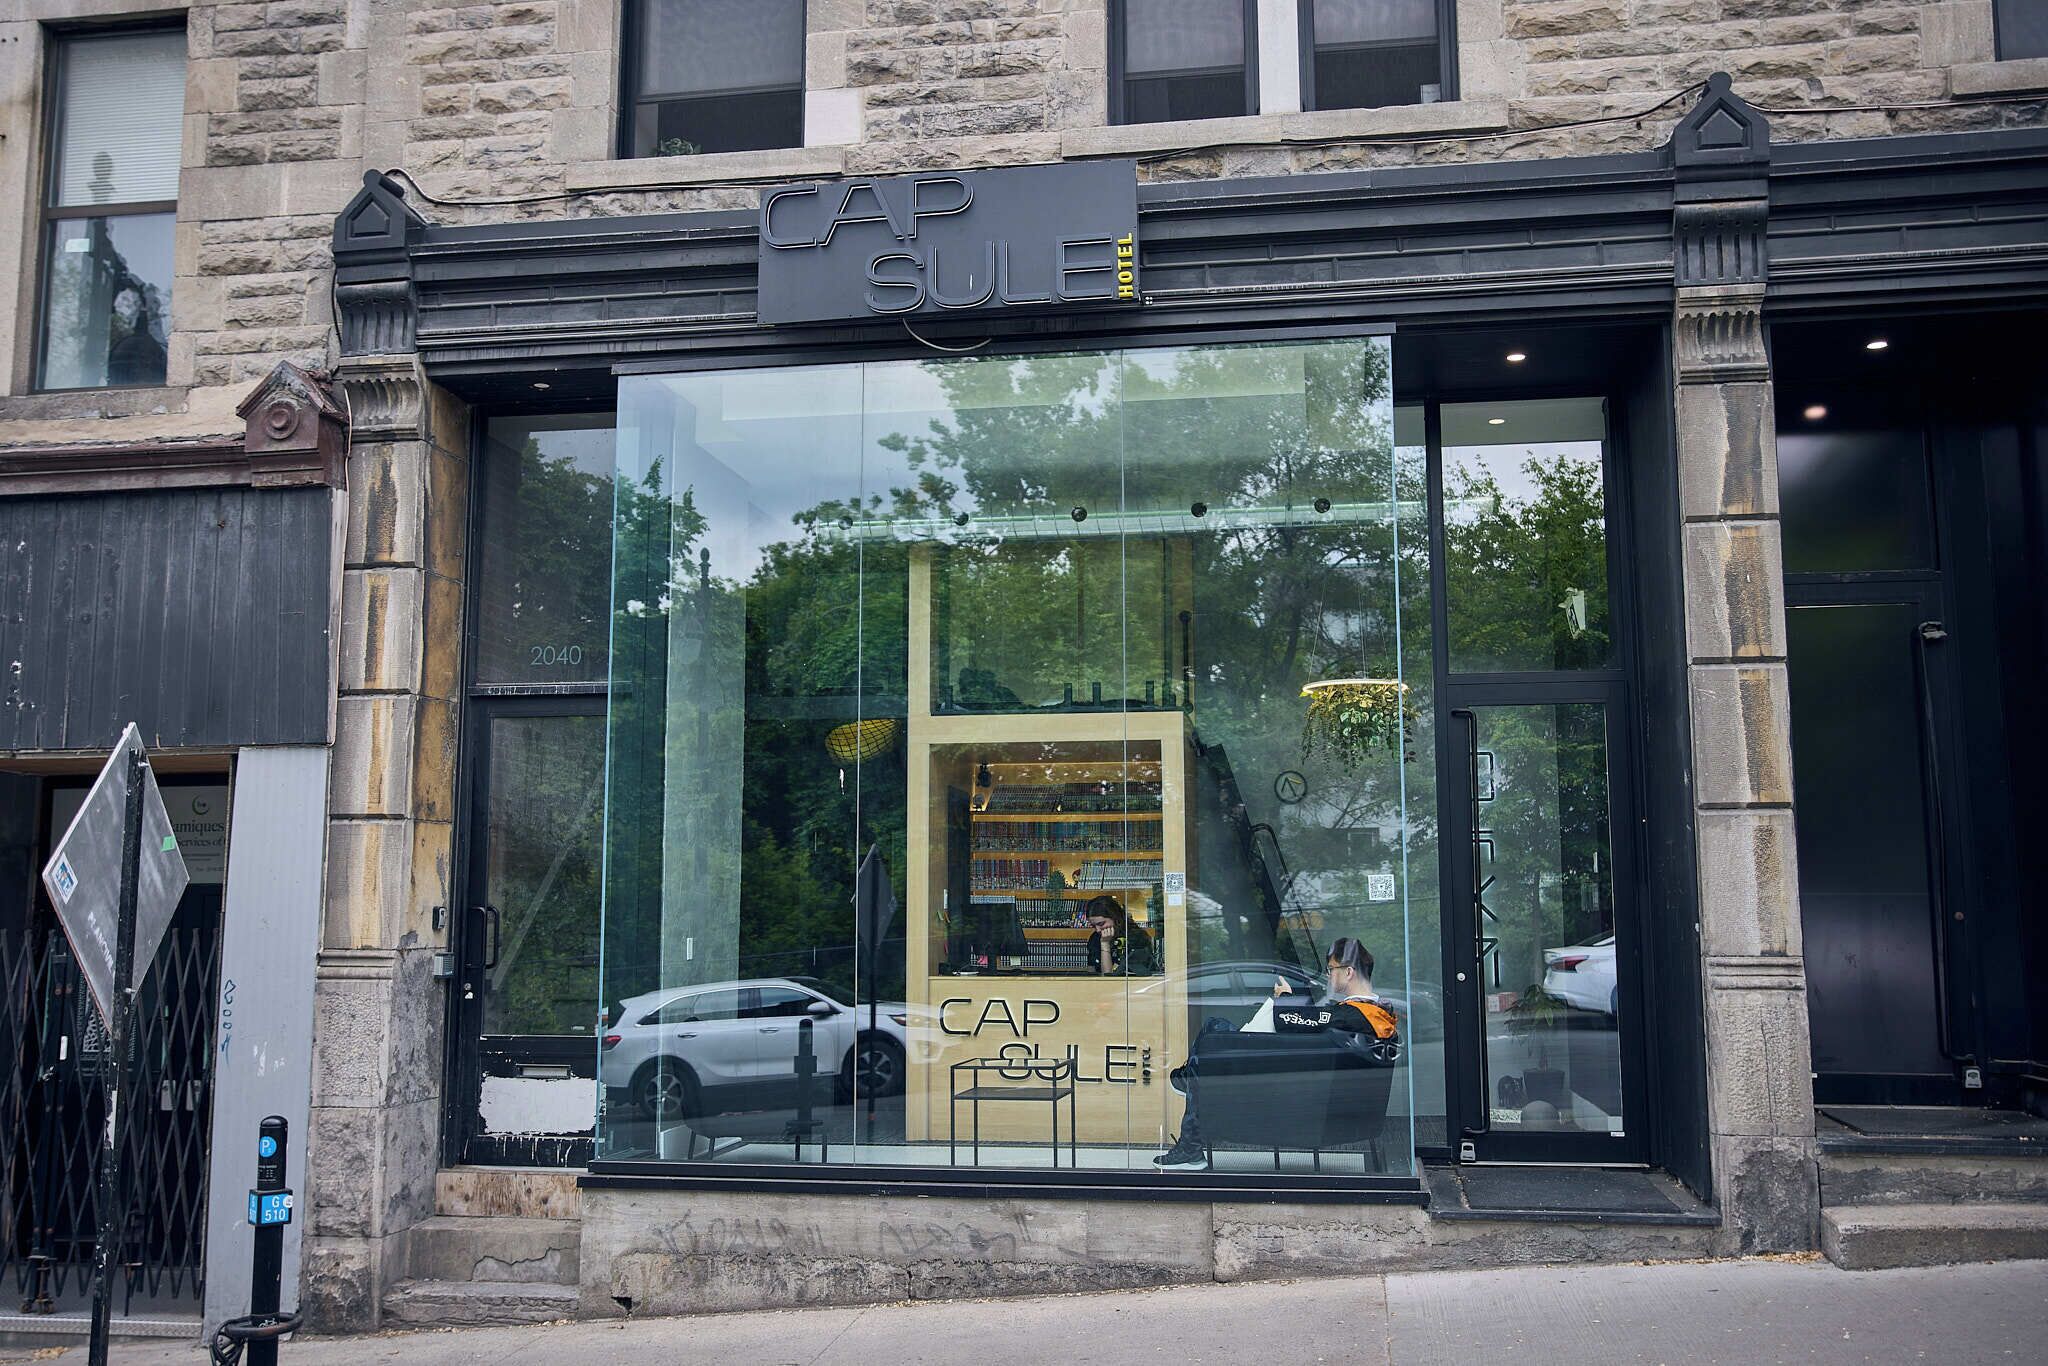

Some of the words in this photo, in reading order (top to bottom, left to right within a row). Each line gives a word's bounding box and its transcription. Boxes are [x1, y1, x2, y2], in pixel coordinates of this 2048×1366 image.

[761, 176, 974, 249] CAP
[864, 232, 1113, 314] SULE
[1117, 232, 1134, 298] HOTEL
[530, 645, 582, 665] 2040
[939, 998, 1061, 1038] CAP
[999, 1043, 1137, 1083] SULE
[264, 1208, 286, 1222] 510
[272, 1195, 280, 1209] G
